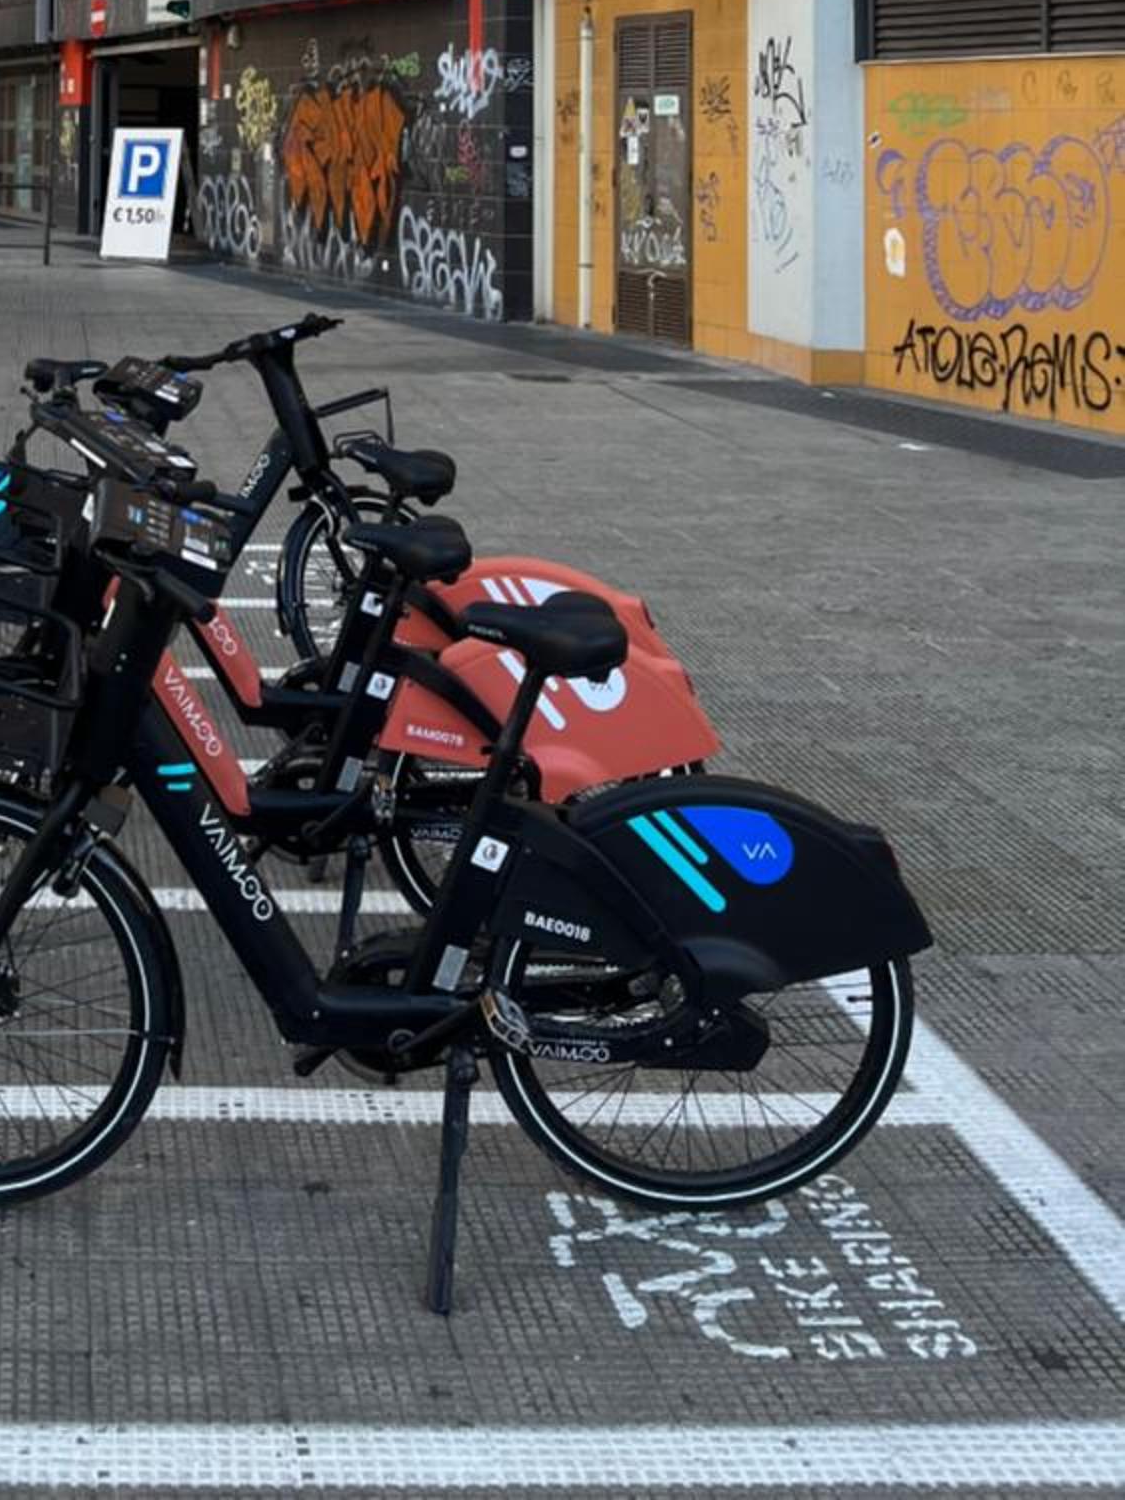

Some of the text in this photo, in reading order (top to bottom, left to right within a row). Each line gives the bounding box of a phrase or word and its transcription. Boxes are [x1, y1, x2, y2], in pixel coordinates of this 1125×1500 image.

[127, 145, 161, 192] P
[162, 666, 223, 757] VAIMOO
[198, 802, 274, 922] VAIMOO
[524, 910, 591, 942] BAE0018
[528, 1043, 610, 1062] VAIMOO
